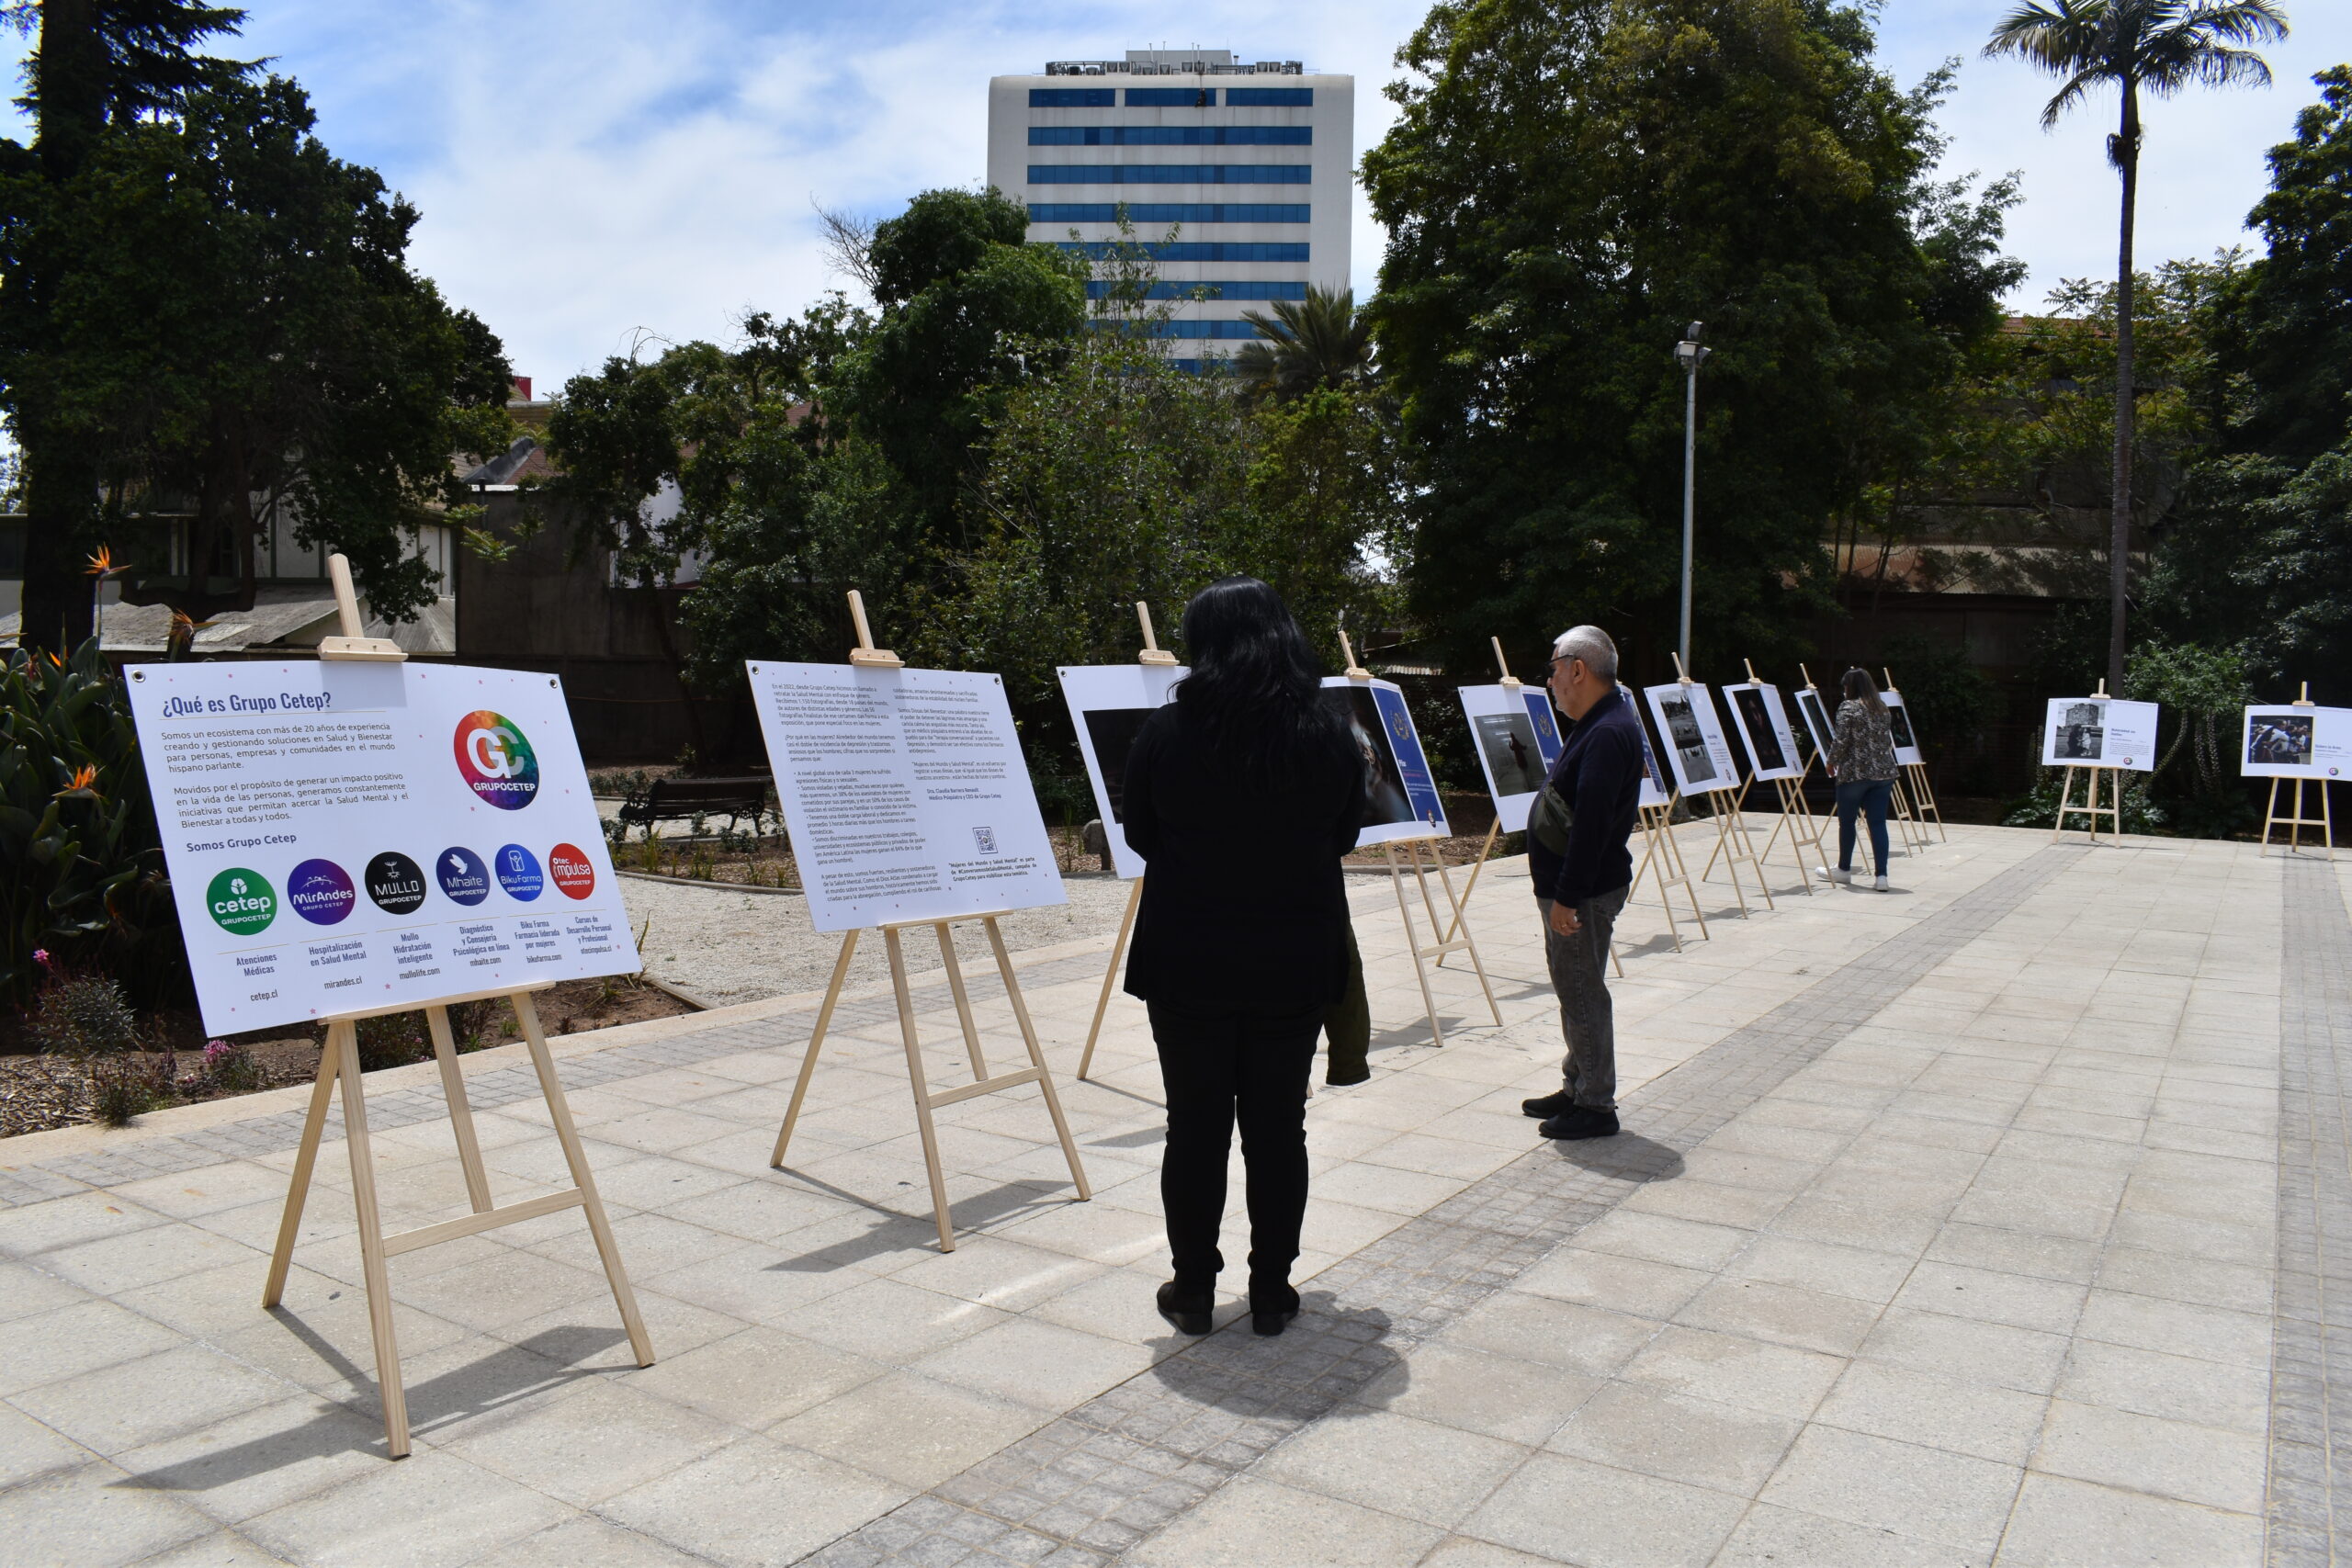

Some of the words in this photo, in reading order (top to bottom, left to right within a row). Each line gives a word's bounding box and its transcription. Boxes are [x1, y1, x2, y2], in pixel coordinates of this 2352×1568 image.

[163, 696, 202, 717] ¿Qué
[207, 699, 225, 712] es
[229, 695, 276, 713] Grupo
[280, 691, 330, 711] Cetep?
[206, 729, 254, 737] ecosistema
[348, 723, 390, 731] experiencia
[164, 742, 199, 750] creando
[211, 739, 264, 749] gestionando
[166, 755, 186, 763] para
[190, 752, 232, 761] personas,
[236, 749, 277, 757] empresas
[168, 765, 203, 773] hispano
[205, 761, 243, 771] parlante.
[174, 785, 211, 794] Movidos
[213, 785, 227, 793] por
[240, 780, 281, 791] propósito
[296, 778, 326, 787] generar
[341, 774, 372, 783] impacto
[373, 773, 403, 781] positivo
[473, 783, 535, 791] GRUPOCETEP
[254, 791, 294, 801] personas,
[297, 787, 341, 797] generamos
[344, 783, 405, 792] constantemente
[178, 807, 222, 817] iniciativas
[226, 806, 243, 814] que
[248, 802, 286, 812] permitan
[336, 795, 358, 804] Salud
[181, 819, 223, 828] Bienestar
[186, 841, 224, 852] Somos
[227, 838, 261, 848] Grupo
[264, 834, 296, 844] Cetep
[447, 876, 483, 888] Mhaite
[500, 875, 542, 884] BikuFarma
[375, 880, 419, 896] MULLO
[449, 888, 487, 897] GRUPOCETEP
[293, 889, 353, 905] MirAndes
[378, 895, 422, 905] GRUPOCETEP
[215, 896, 271, 914] cetep
[221, 913, 271, 925] GRUPOCETEP
[459, 925, 493, 935] Diagnóstico
[566, 925, 591, 934] Desarrollo
[400, 933, 419, 941] Mullo
[581, 933, 608, 942] Profesional
[308, 941, 363, 955] Hospitalización
[393, 942, 431, 953] Hidratación
[452, 946, 487, 956] Psicológica
[236, 954, 277, 965] Atenciones
[320, 954, 341, 964] Salud
[342, 950, 366, 961] Mental
[397, 953, 432, 964] inteligente
[469, 957, 501, 966] mhaite.com
[243, 966, 274, 976] Médicas
[399, 968, 440, 979] mullolife.com
[324, 977, 362, 989] mirandes.cl
[250, 990, 278, 1001] cetep.cl
